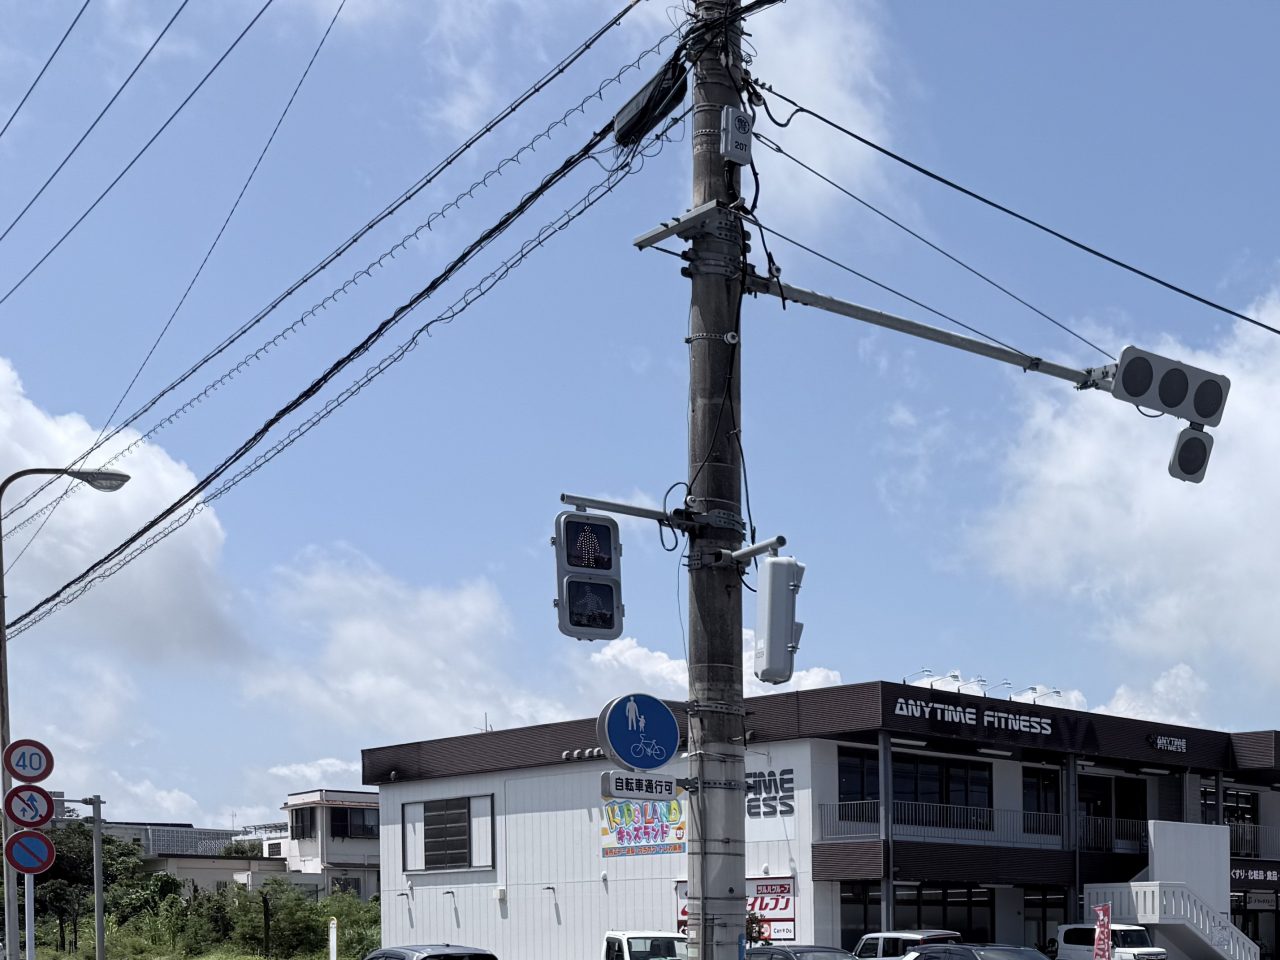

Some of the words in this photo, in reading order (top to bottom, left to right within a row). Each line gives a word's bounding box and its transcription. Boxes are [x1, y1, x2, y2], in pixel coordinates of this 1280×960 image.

[894, 698, 977, 725] ANYTIME
[984, 711, 1052, 735] FITNESS
[15, 751, 42, 771] 40
[615, 777, 673, 794] 自転車通行可
[643, 800, 680, 824] LAND
[617, 824, 670, 844] キッズランド
